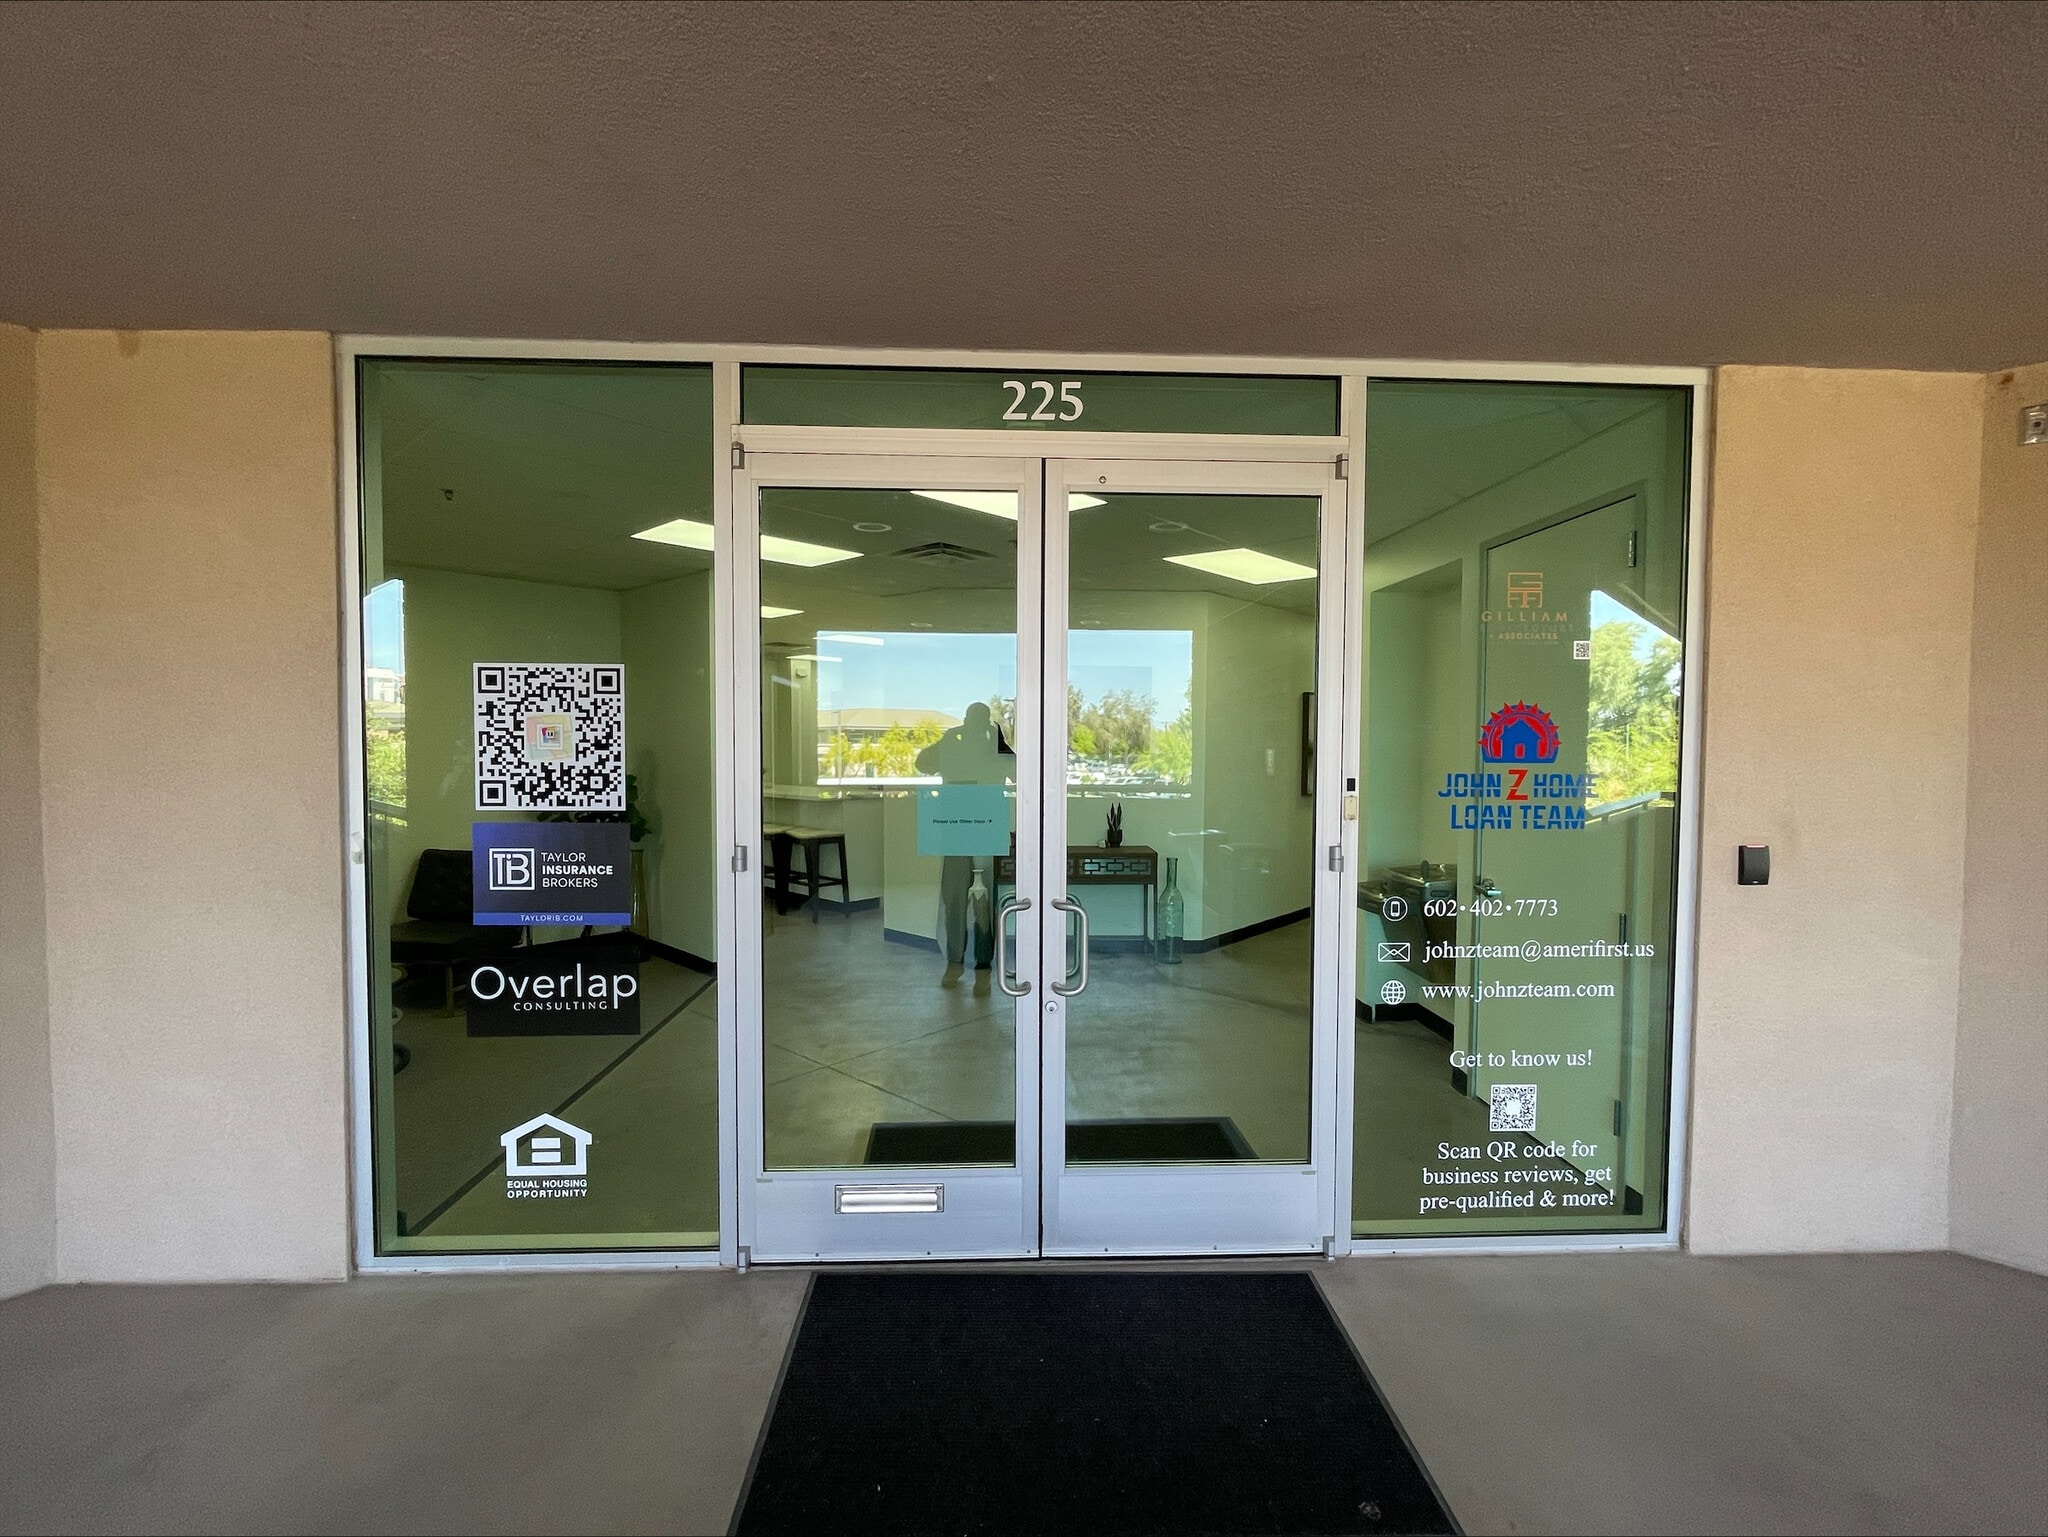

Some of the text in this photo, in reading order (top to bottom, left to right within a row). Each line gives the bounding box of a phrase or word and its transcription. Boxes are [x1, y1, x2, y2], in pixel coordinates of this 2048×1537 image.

[1002, 380, 1085, 422] 225
[1481, 610, 1568, 622] GILLIAM
[1498, 632, 1558, 640] ASSOCIATES
[1438, 769, 1600, 801] JOHN Z HOME
[1450, 804, 1585, 830] LOAN TEAM
[541, 852, 586, 862] TAYLOR
[542, 865, 614, 875] INSURANCE
[542, 877, 598, 888] BROKERS
[1422, 940, 1654, 963] johnzteam@amerifirst.us
[470, 962, 637, 1009] Overlap
[1421, 981, 1615, 1002] www.johnzteam.com
[513, 1000, 608, 1011] CONSULTING
[1449, 1049, 1593, 1068] Get to know us!
[1438, 1139, 1598, 1162] Scan QR code for
[507, 1179, 587, 1189] EQUAL HOUSING
[1422, 1165, 1612, 1186] business reviews, get
[507, 1189, 587, 1198] OPPORTUNITY
[1419, 1189, 1615, 1213] pre-qualified & more!
